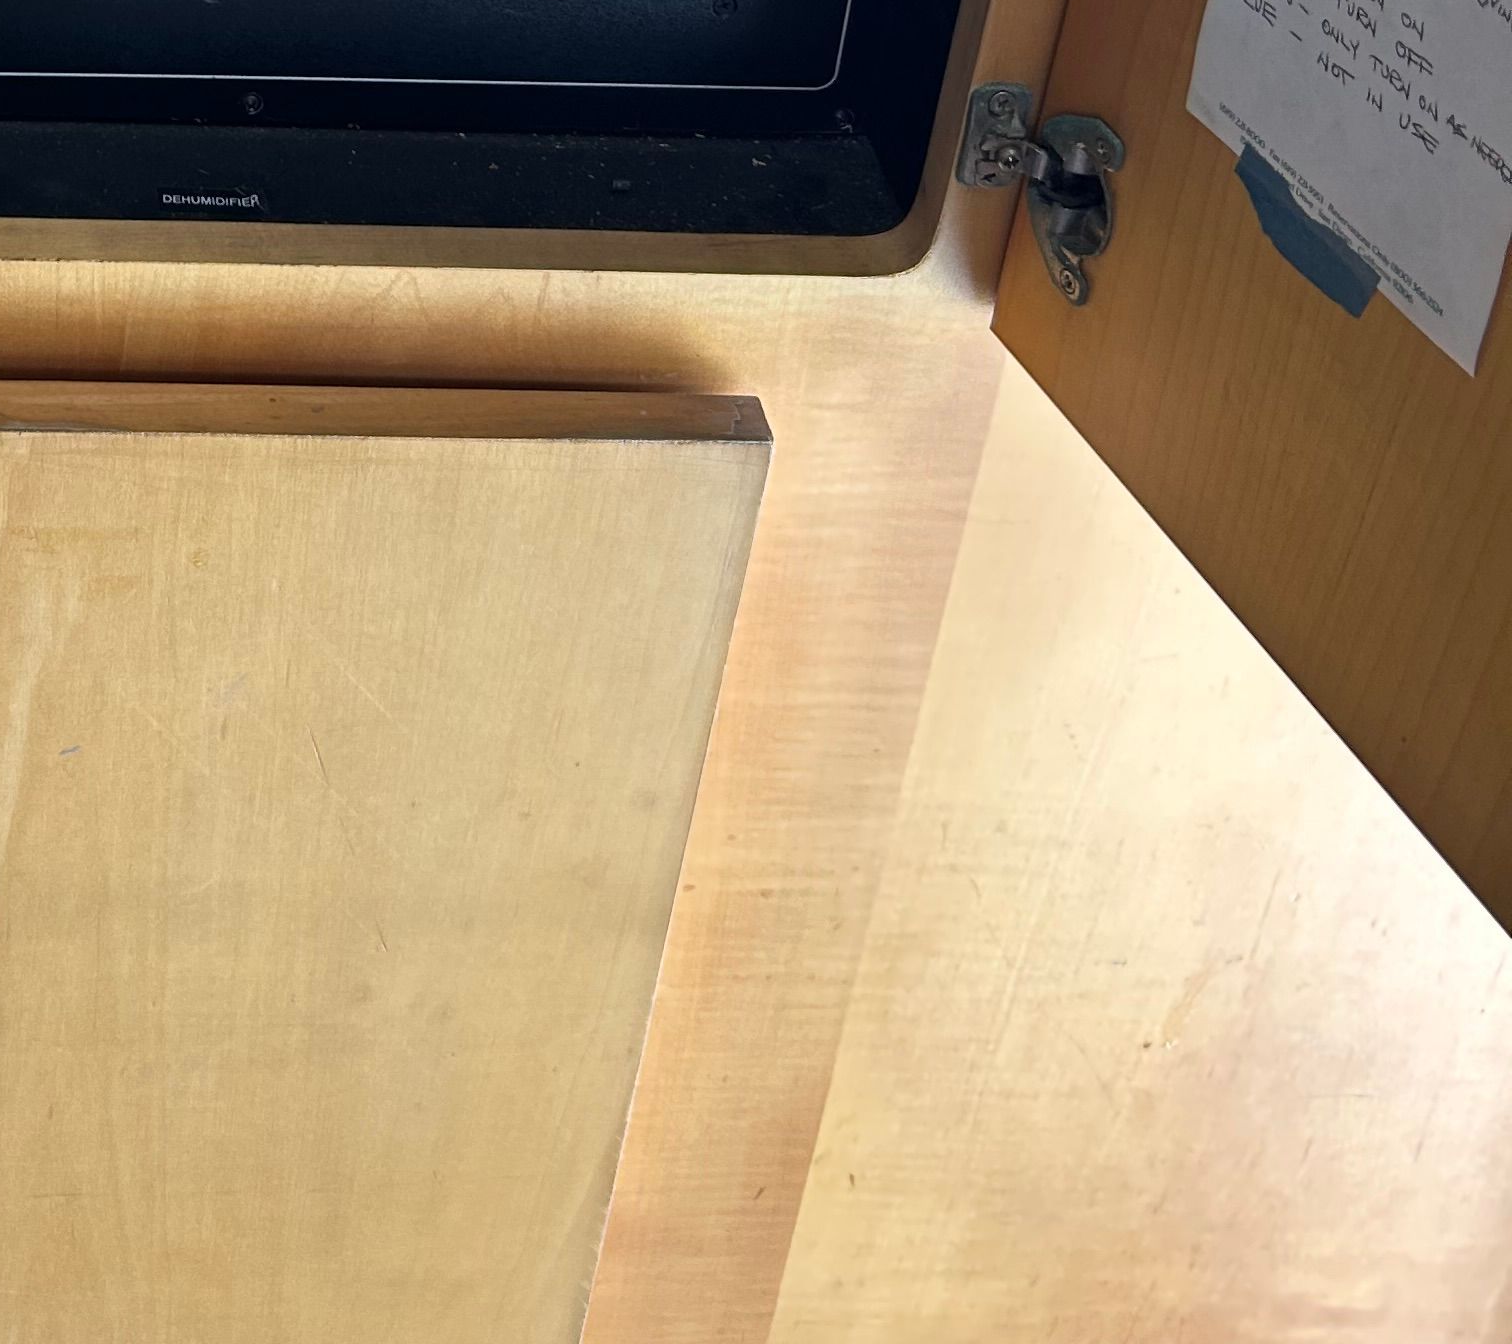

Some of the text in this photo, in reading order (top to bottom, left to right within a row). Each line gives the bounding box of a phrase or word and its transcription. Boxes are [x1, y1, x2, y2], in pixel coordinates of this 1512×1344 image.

[1401, 12, 1424, 40] ON
[1322, 19, 1360, 60] ONLY
[1369, 54, 1410, 100] TURN
[1419, 95, 1438, 122] ON
[1395, 41, 1433, 75] OFF
[1317, 52, 1355, 85] NOT
[1367, 88, 1382, 111] IN
[1399, 113, 1439, 154] USE
[162, 194, 260, 208] DEHUMIDIFIER
